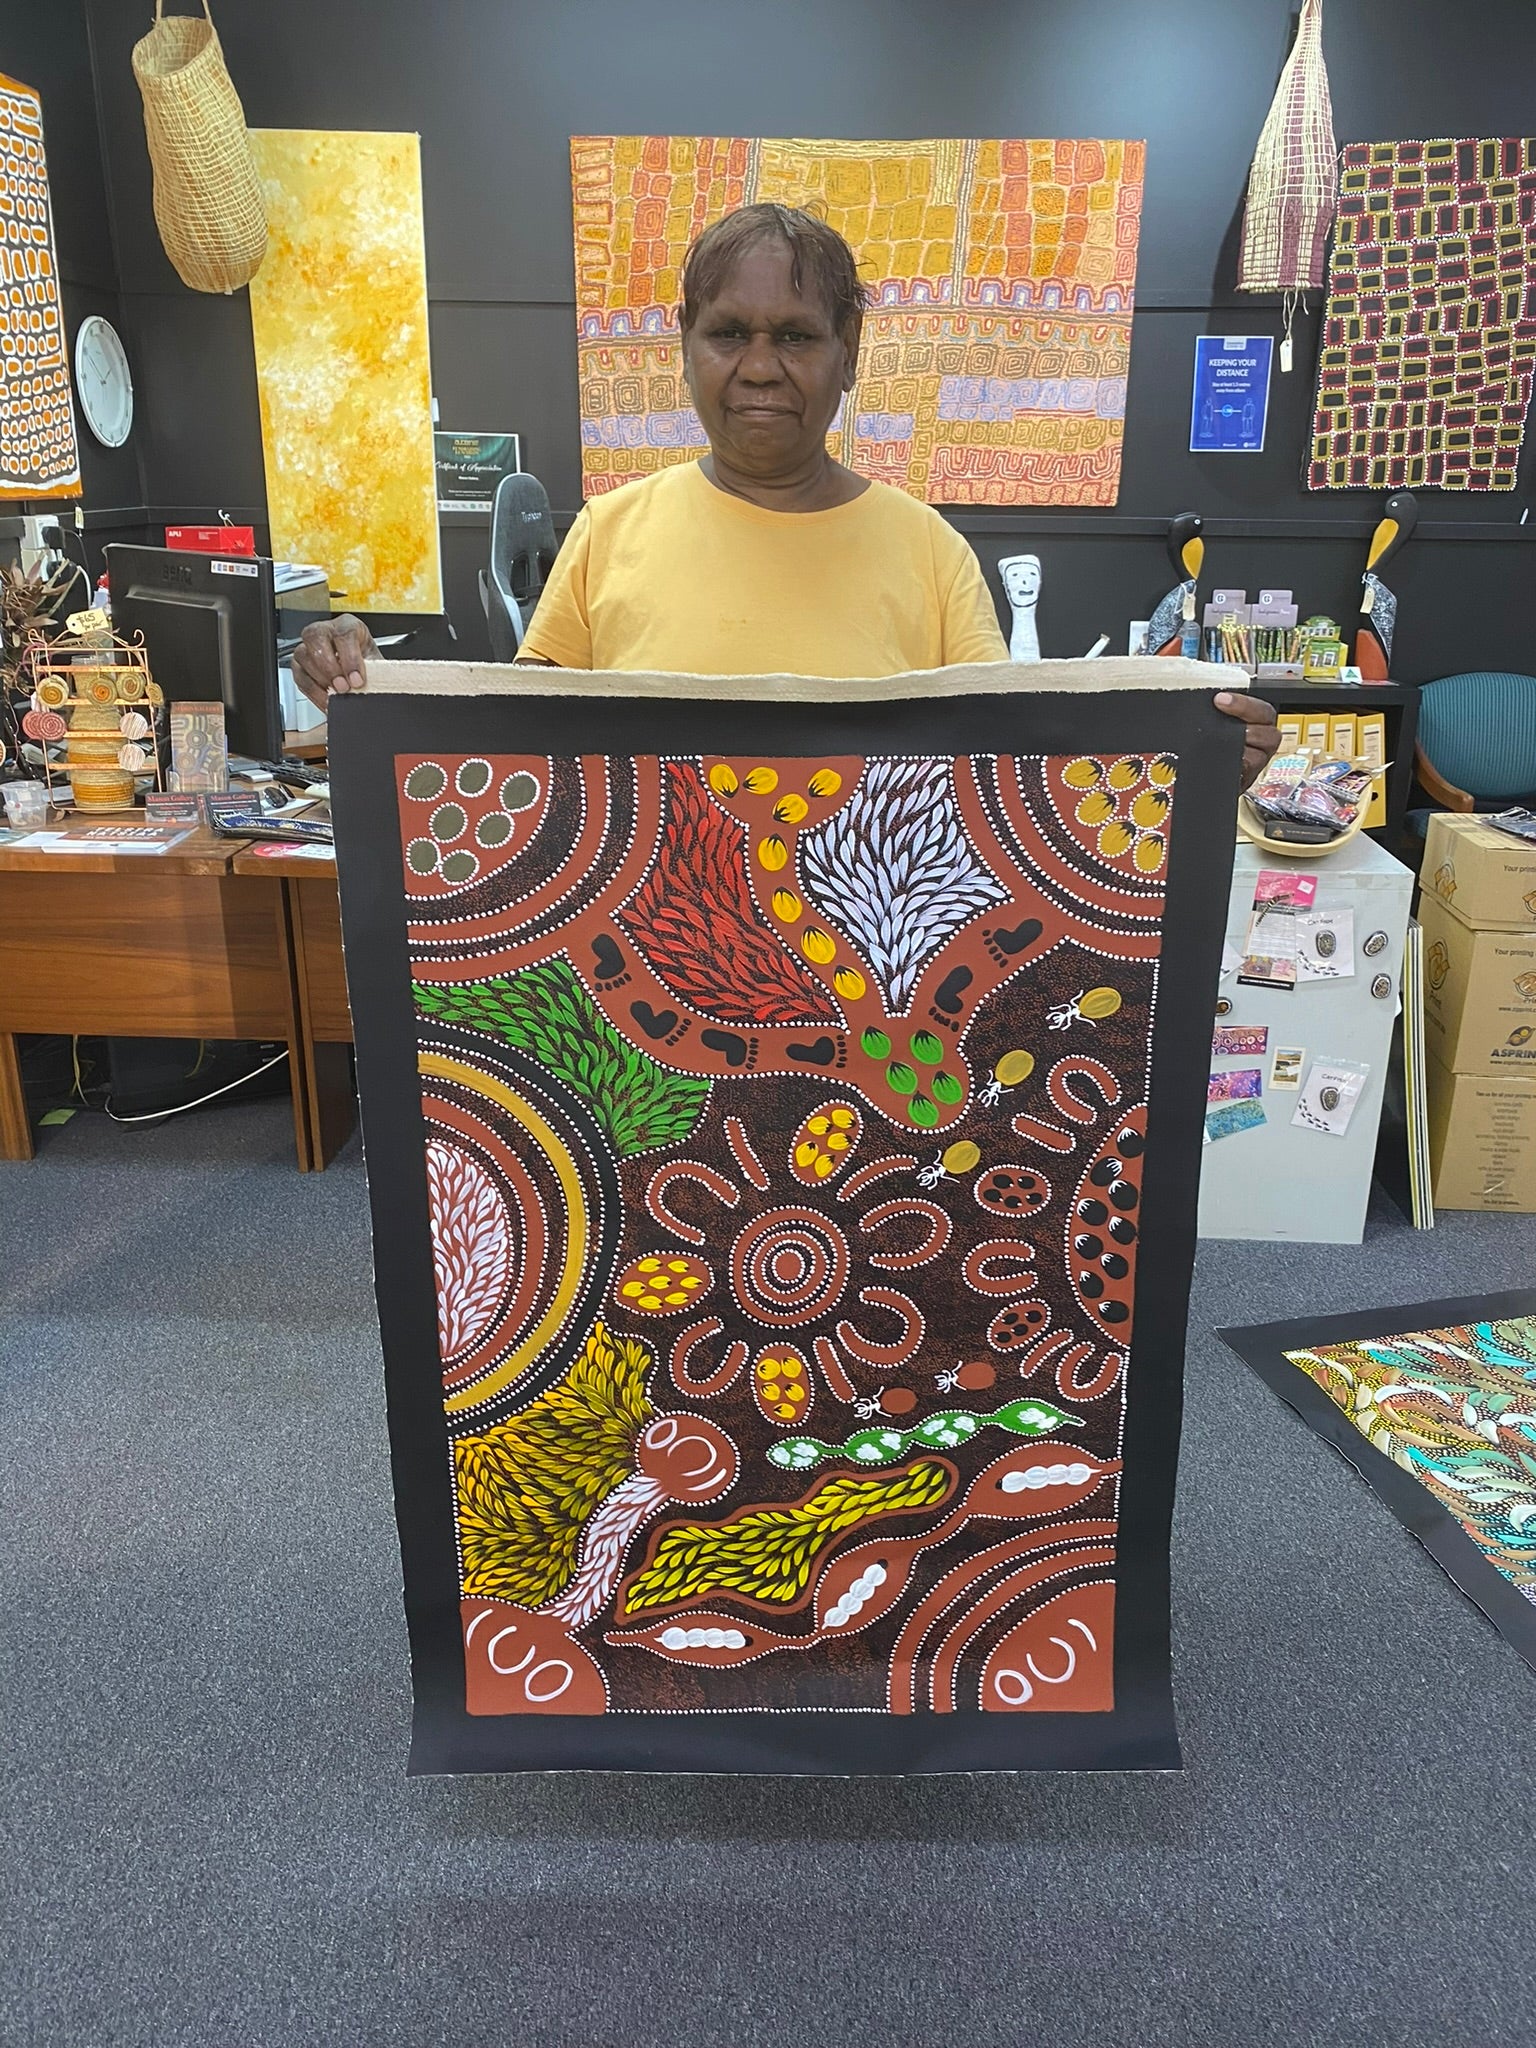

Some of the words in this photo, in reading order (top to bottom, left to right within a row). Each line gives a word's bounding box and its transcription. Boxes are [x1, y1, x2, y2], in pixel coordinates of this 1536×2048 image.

[1209, 359, 1237, 367] KEEPING
[1238, 359, 1257, 367] YOUR
[1216, 369, 1249, 377] DISTANCE
[76, 612, 96, 623] $65
[171, 795, 194, 803] Gallery
[233, 794, 256, 802] Gallery
